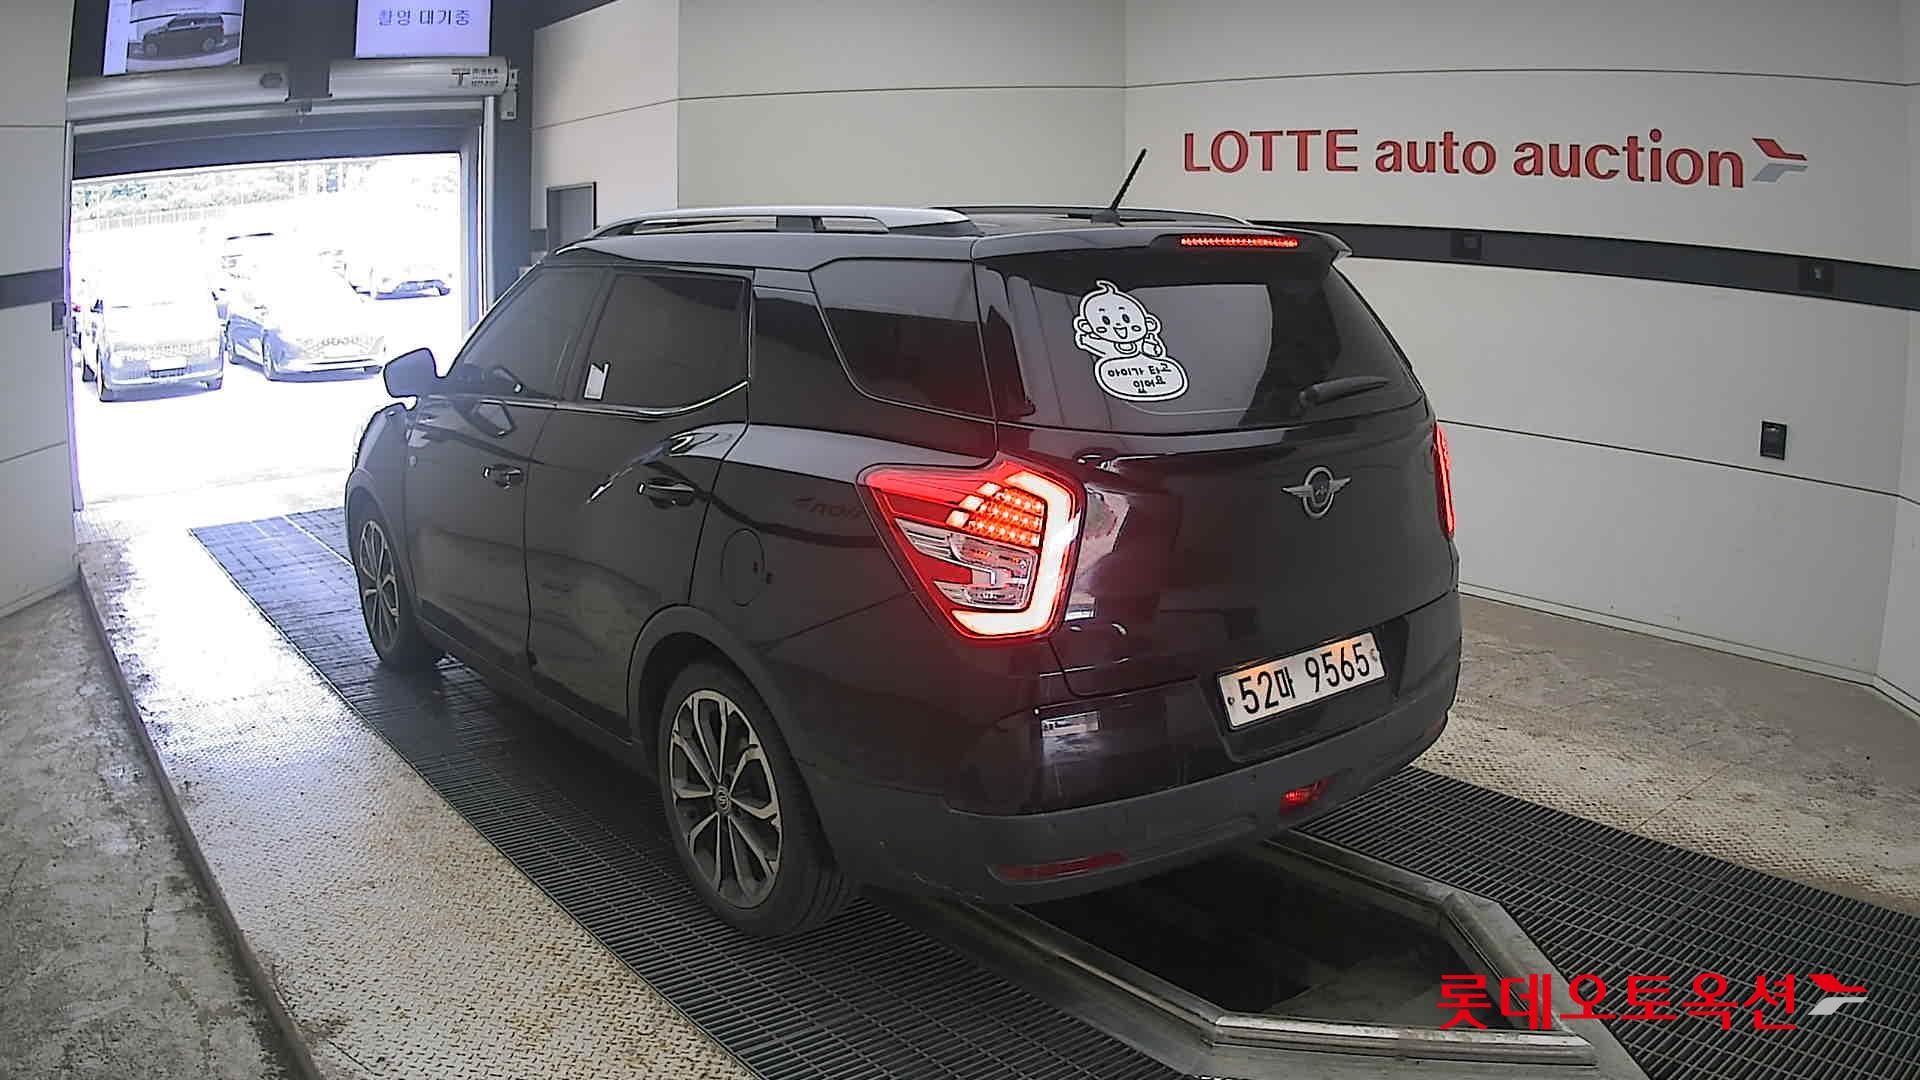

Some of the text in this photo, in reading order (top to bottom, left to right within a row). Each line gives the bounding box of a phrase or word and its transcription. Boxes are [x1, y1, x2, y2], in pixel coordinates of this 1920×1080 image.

[419, 9, 470, 25] 대기중
[1184, 128, 1745, 189] LOTTE auto auction
[1107, 363, 1172, 377] 아이가 타고
[1133, 375, 1166, 393] 있어요
[1237, 642, 1371, 715] 52마 9565
